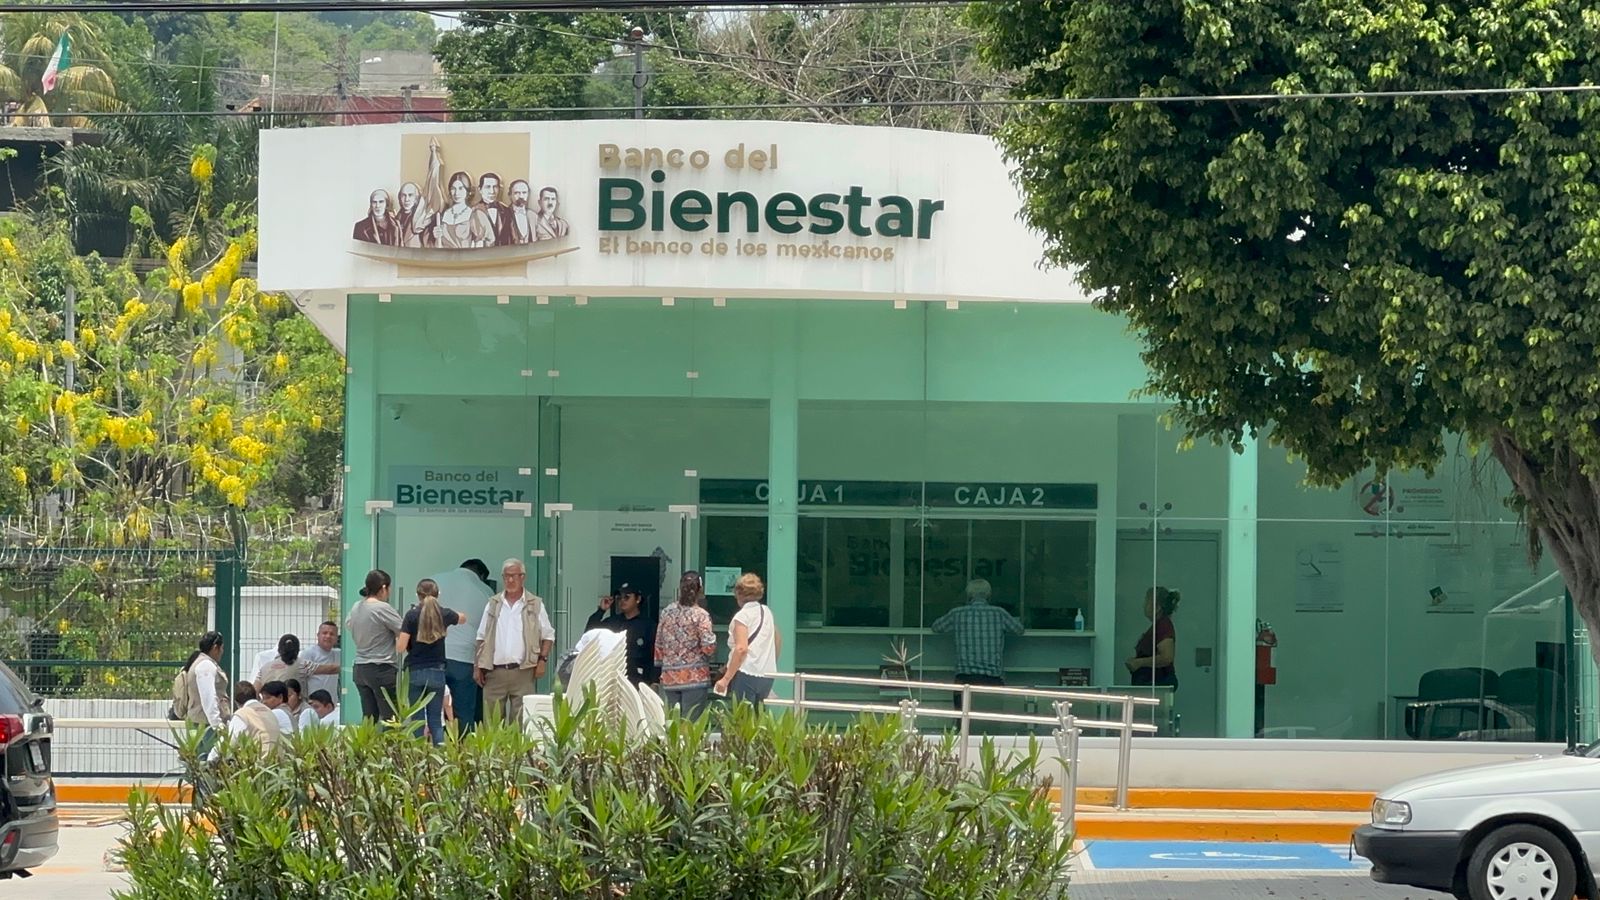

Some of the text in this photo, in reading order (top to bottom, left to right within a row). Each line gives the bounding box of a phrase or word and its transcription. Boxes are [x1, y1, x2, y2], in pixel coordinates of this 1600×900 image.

[598, 143, 778, 170] Banco del
[598, 169, 945, 240] Bienestar
[599, 237, 895, 261] El banco de los mexicanos
[424, 470, 499, 482] Banco del
[396, 483, 525, 506] Bienestar
[755, 482, 827, 503] CJA
[954, 486, 1027, 506] CAJA
